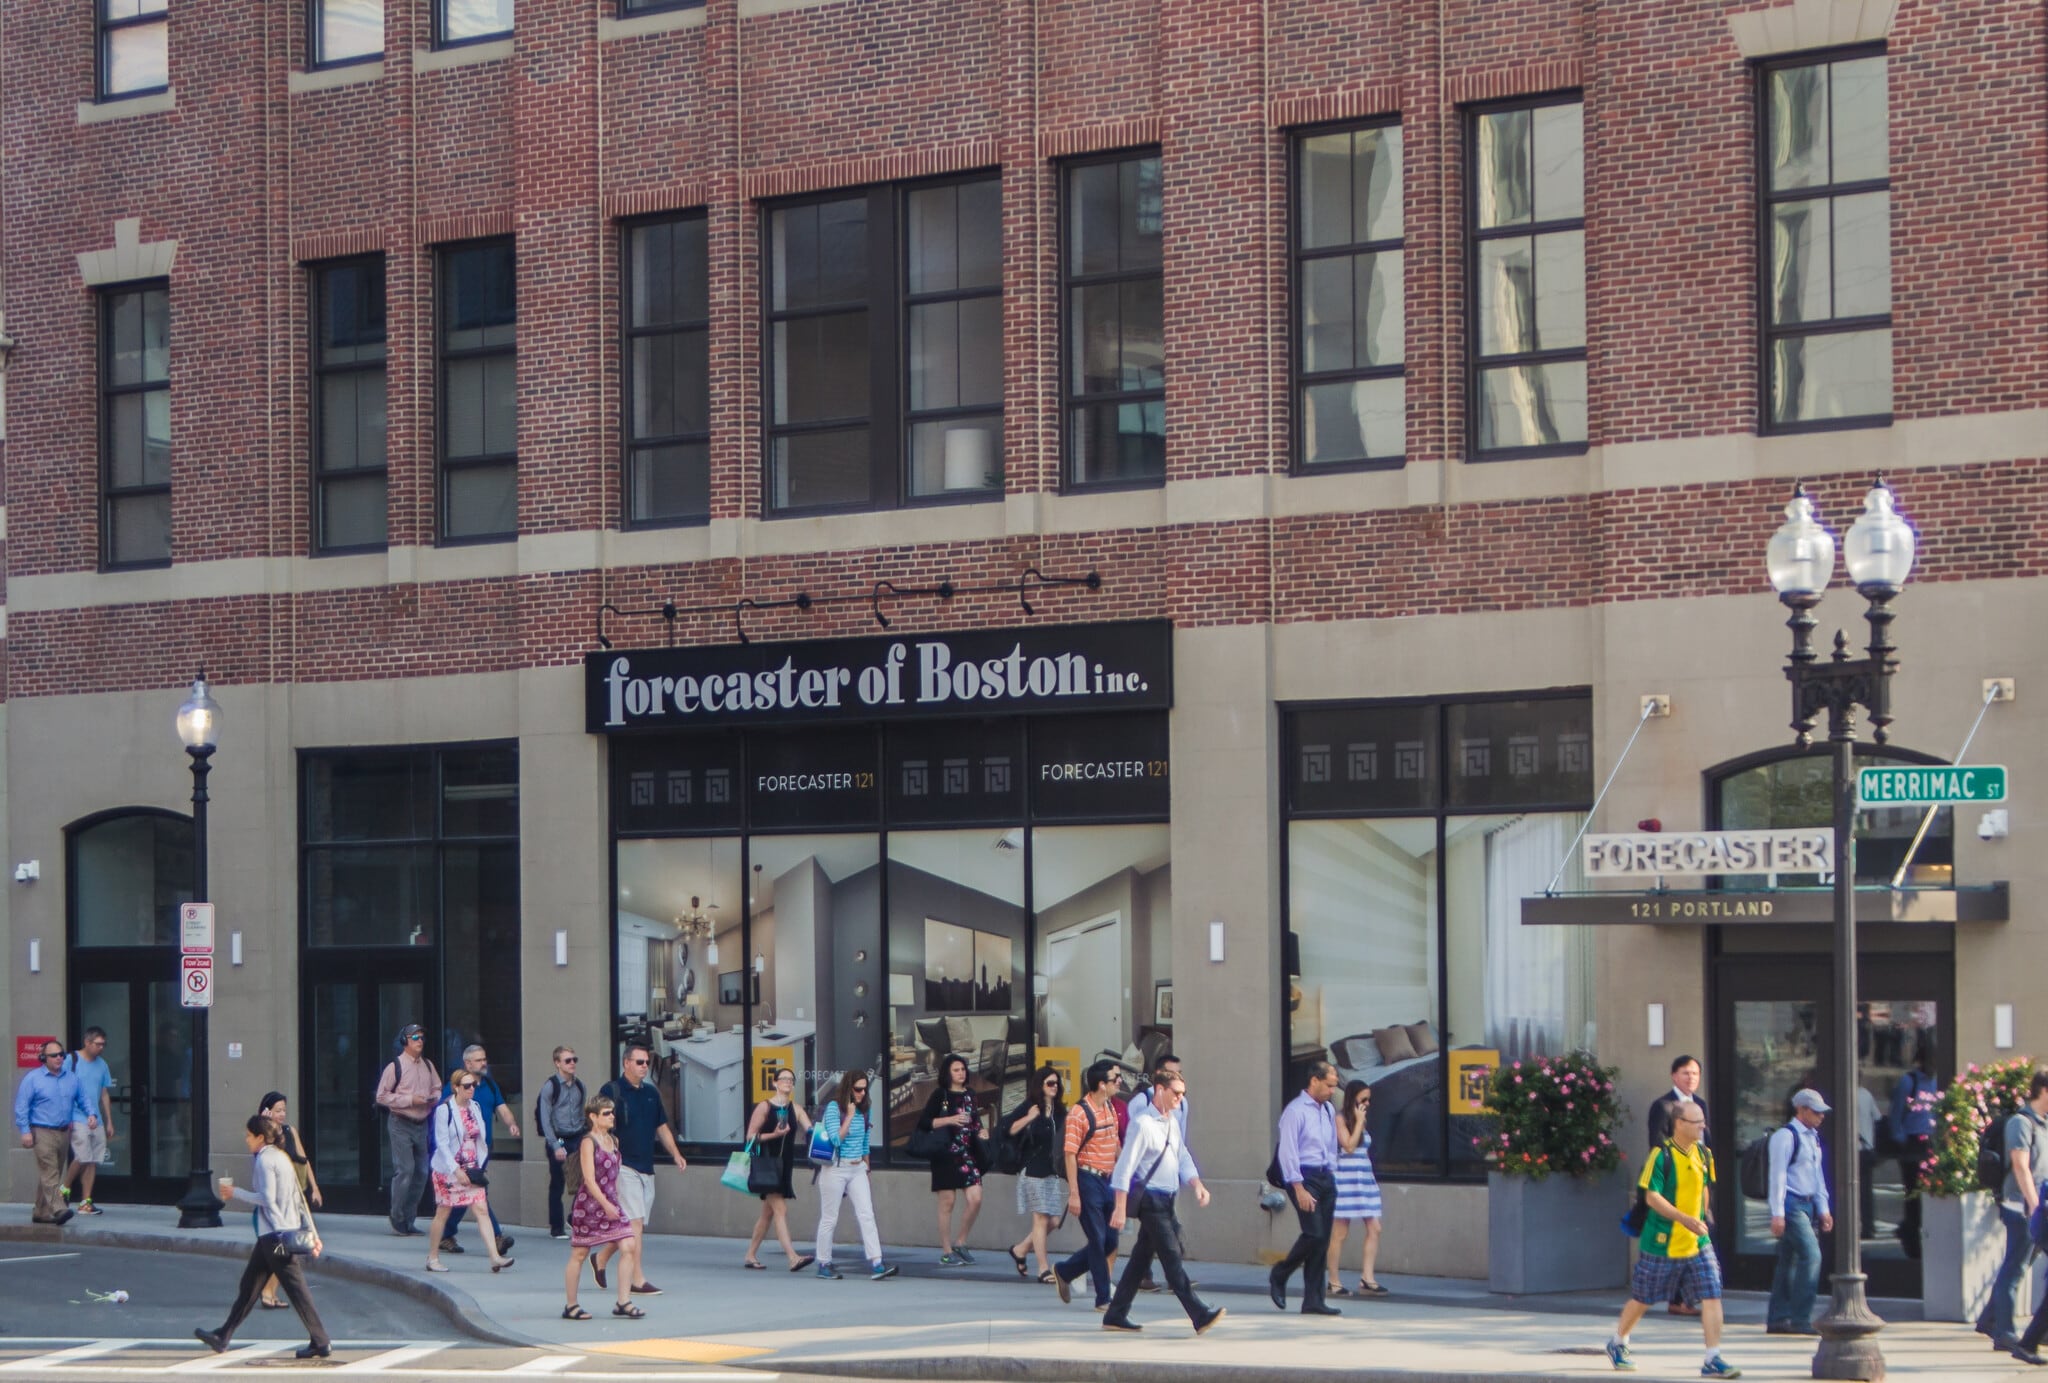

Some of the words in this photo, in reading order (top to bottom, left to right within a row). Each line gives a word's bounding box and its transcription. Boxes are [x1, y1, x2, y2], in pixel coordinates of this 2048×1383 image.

[604, 656, 851, 726] forecaster
[858, 643, 907, 704] of
[916, 642, 1091, 702] Boston
[1094, 663, 1149, 694] inc.
[758, 773, 852, 792] FORECASTER
[854, 772, 874, 789] 121
[1041, 761, 1144, 781] FORECASTER
[1147, 760, 1168, 777] 121
[1864, 772, 1976, 800] MERRIMAC
[1986, 783, 2000, 798] ST
[1589, 834, 1829, 872] FORECASTER
[1631, 902, 1661, 917] 121
[1670, 901, 1774, 917] PORTLAND
